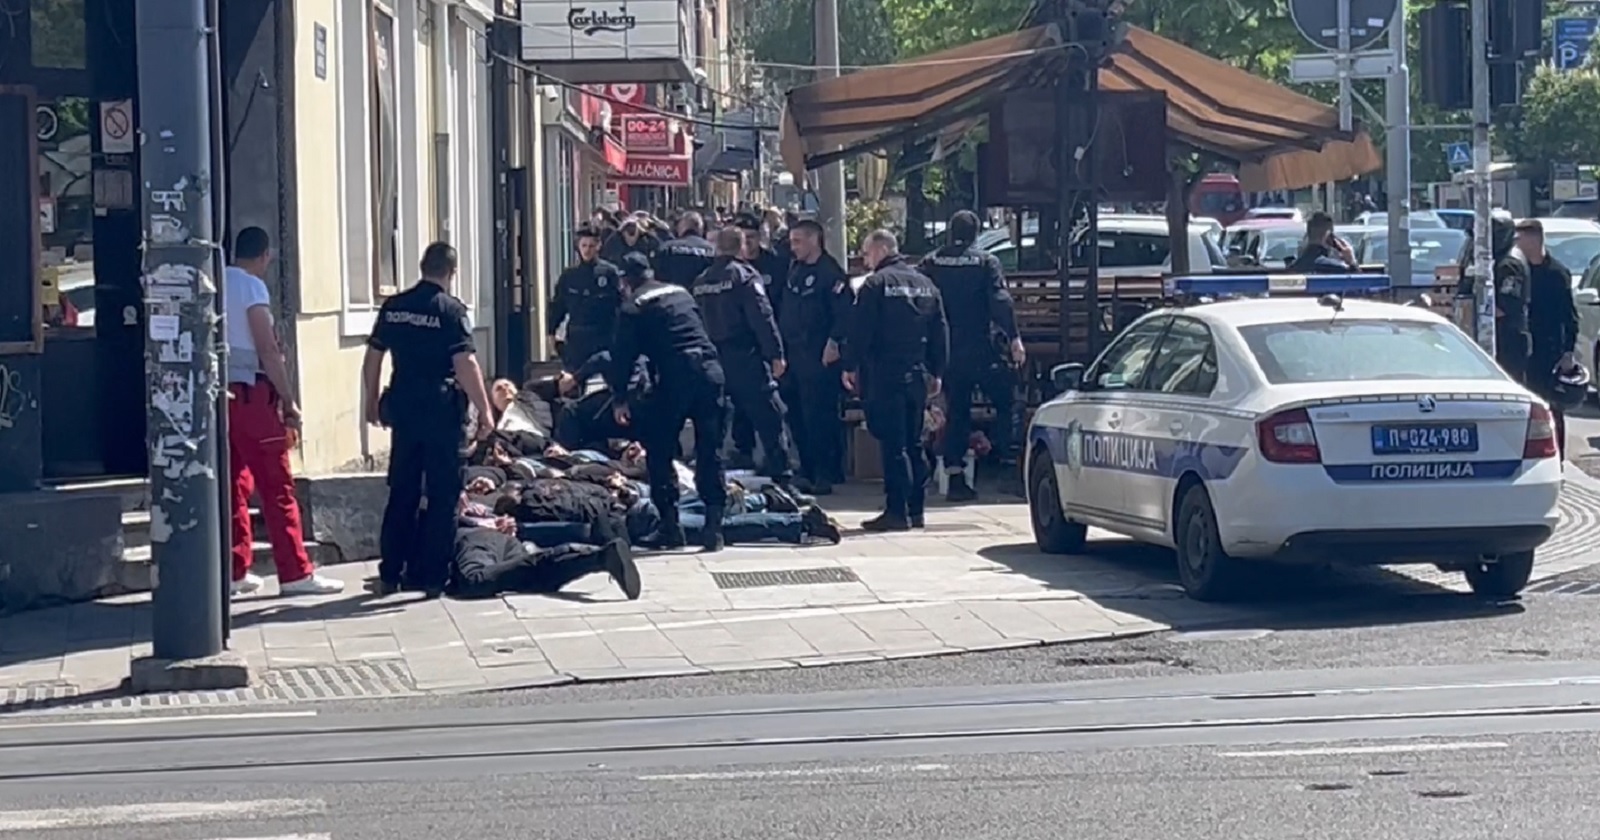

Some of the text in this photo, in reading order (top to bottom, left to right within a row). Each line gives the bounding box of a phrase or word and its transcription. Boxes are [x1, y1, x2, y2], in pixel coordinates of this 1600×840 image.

[568, 7, 635, 36] Carlsberg
[1084, 435, 1158, 469] ПОЛИЦИЈА
[1371, 462, 1475, 478] ПОЛИЦИЈА
